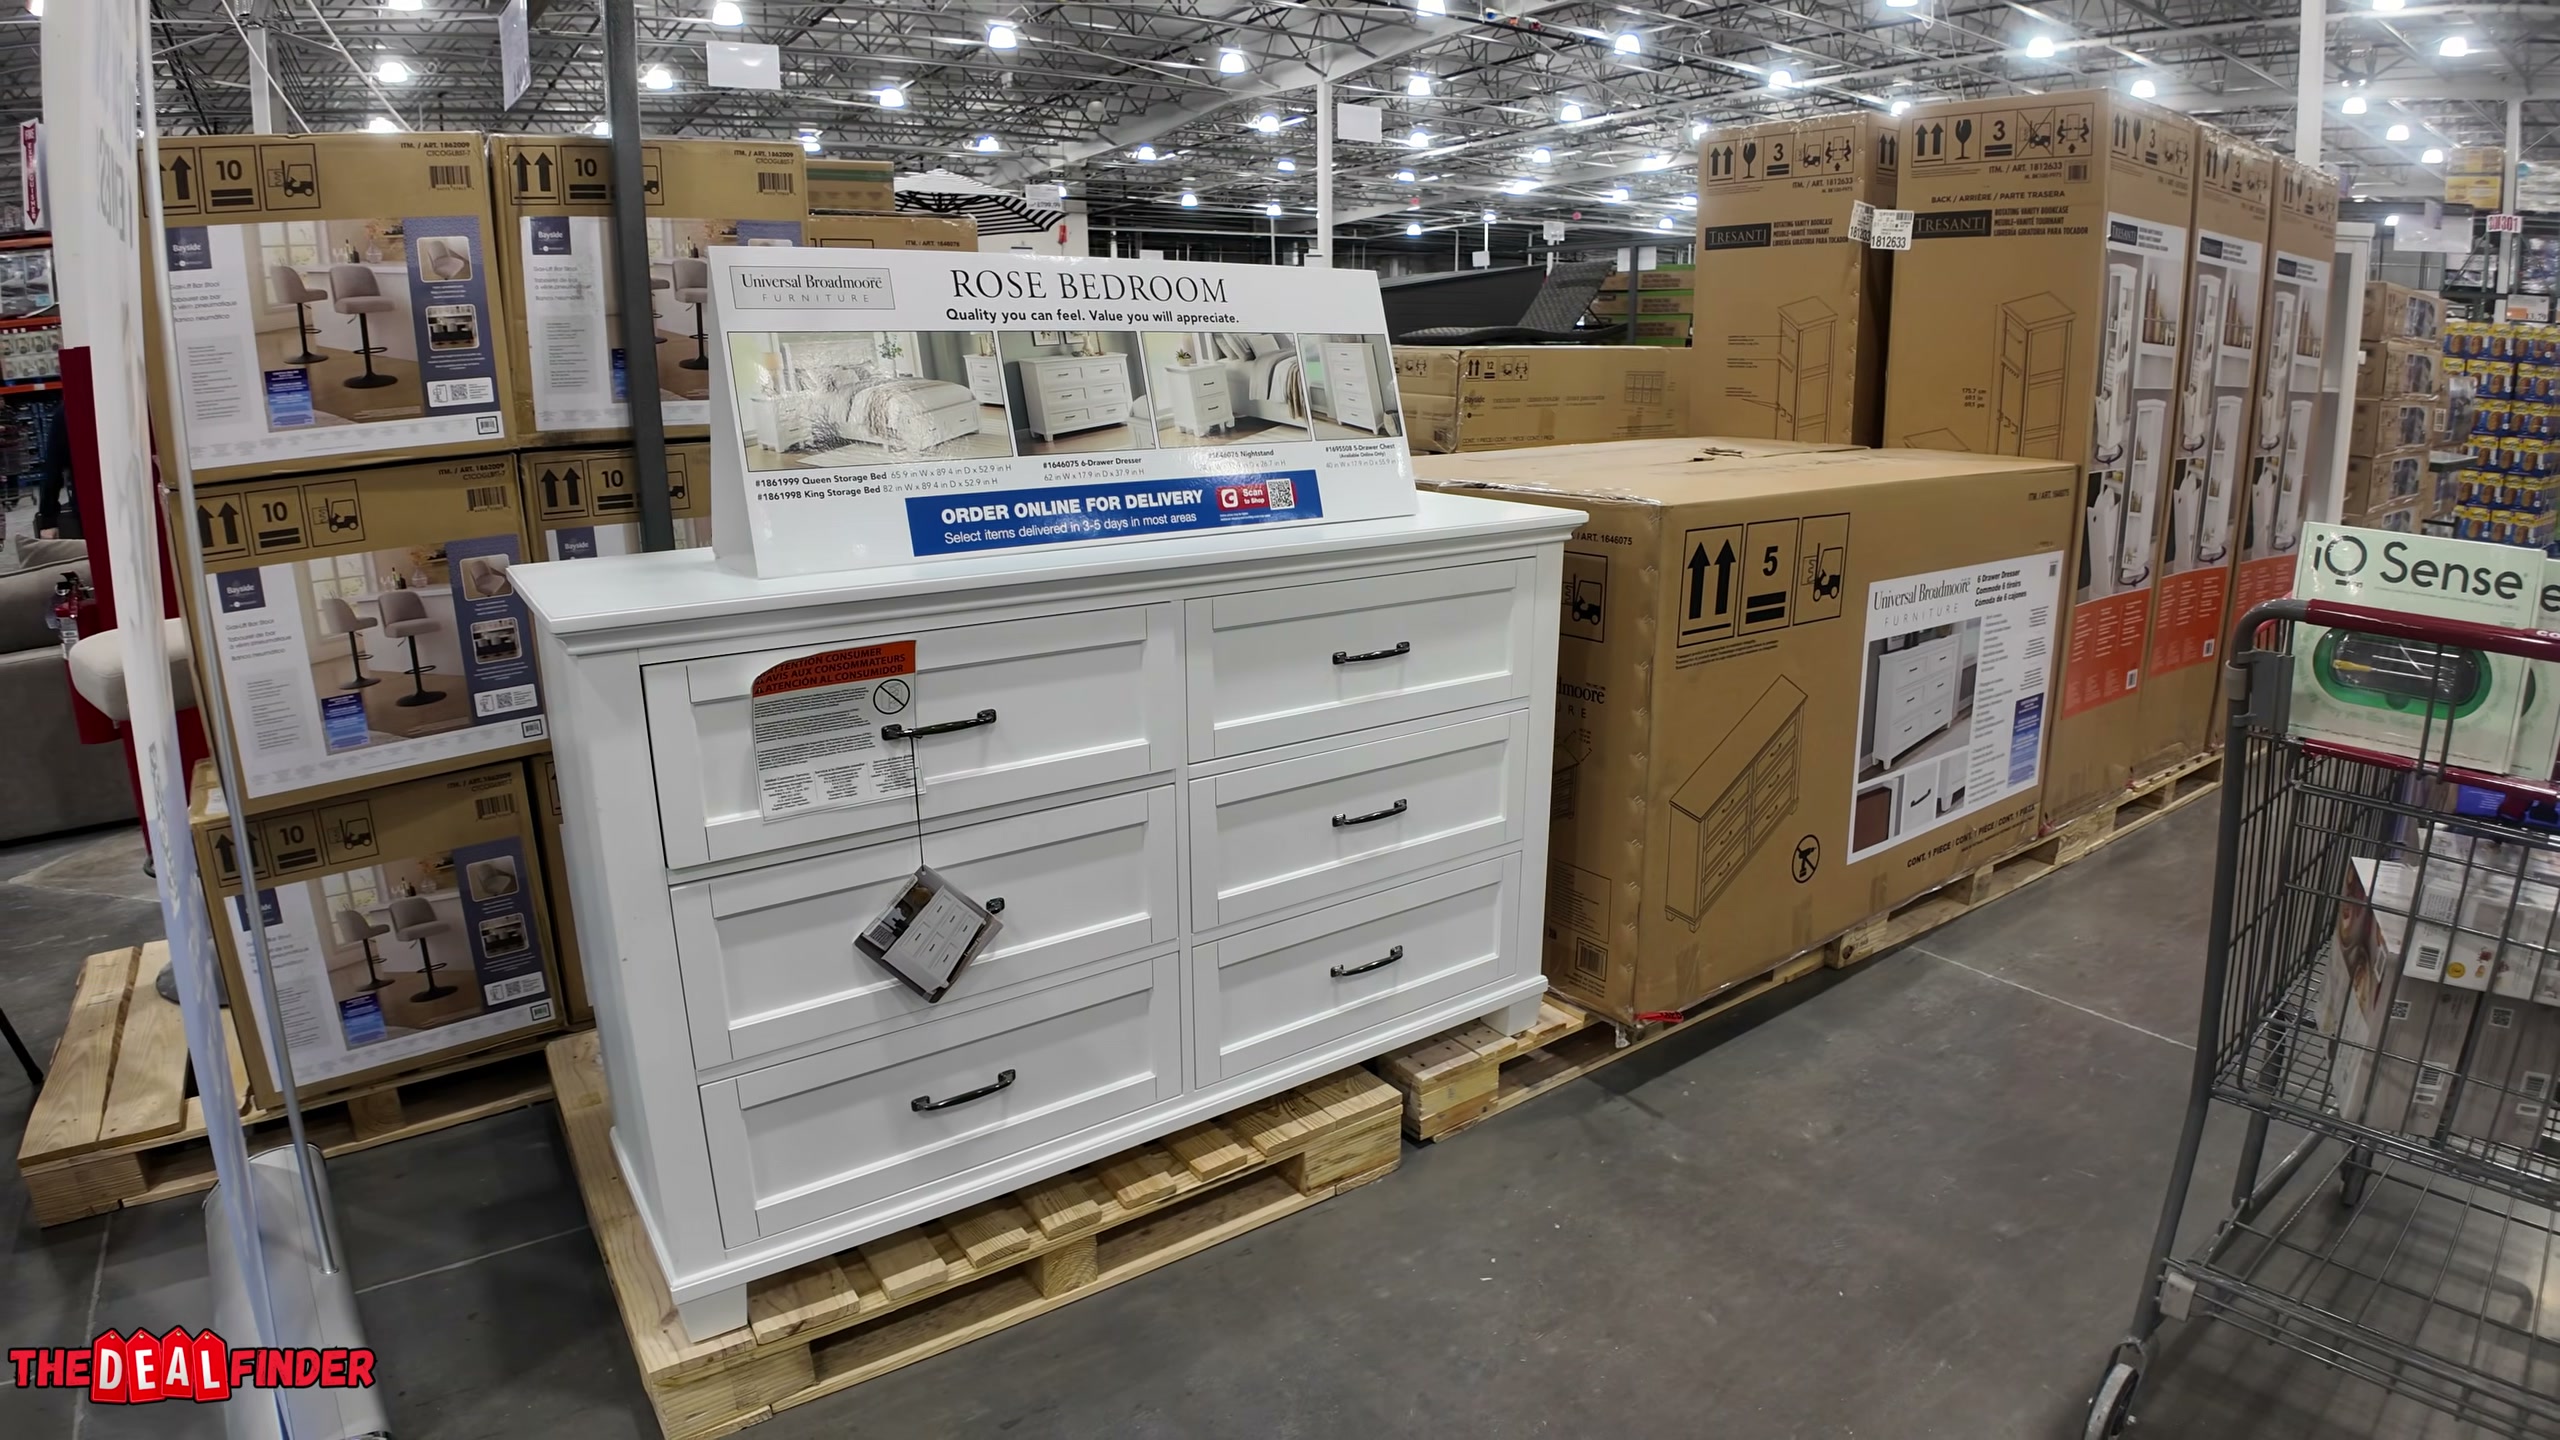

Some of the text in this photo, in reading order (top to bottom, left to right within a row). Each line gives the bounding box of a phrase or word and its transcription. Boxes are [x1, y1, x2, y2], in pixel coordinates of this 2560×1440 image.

[1992, 120, 2006, 141] 3
[2149, 129, 2156, 148] 3
[1772, 142, 1785, 162] 3
[215, 159, 243, 183] 10
[574, 157, 599, 178] 10
[2012, 164, 2027, 172] ART.
[2030, 162, 2062, 171] 1812633
[1812, 179, 1824, 187] ART.
[1827, 177, 1853, 186] 1812633
[2000, 192, 2025, 200] PARTE
[2028, 190, 2065, 199] TRASERA
[1915, 216, 1986, 232] TRESANTI
[538, 231, 563, 240] Bayside
[1872, 236, 1906, 248] 1812633
[173, 243, 201, 253] Bayside
[741, 274, 883, 289] Universal Broadmoore
[950, 270, 1228, 302] ROSE BEDROOM
[762, 293, 869, 303] FURNITURE
[946, 308, 1240, 325] Quality you can feel. Value you will appreciate.
[1240, 450, 1274, 458] Nightstand
[602, 470, 623, 488] 10
[755, 478, 800, 487] #1861999
[802, 476, 832, 485] Queen
[834, 473, 868, 484] Storage
[870, 472, 887, 480] Bed
[919, 469, 928, 477] W
[955, 467, 962, 475] in
[964, 466, 971, 474] D
[804, 489, 825, 501] King
[827, 486, 862, 498] Storage
[864, 485, 881, 494] Bed
[883, 484, 893, 492] 82
[904, 483, 913, 491] W
[941, 481, 948, 489] in
[949, 480, 956, 488] D
[1242, 489, 1263, 497] Scan
[261, 502, 287, 523] 10
[940, 489, 1204, 526] ORDER ONLINE FOR DELIVERY
[944, 511, 1197, 545] Select items delivered in 3-5 days in most areas
[565, 541, 589, 550] Bayside
[1581, 533, 1633, 546] ART. 1646075
[1762, 546, 1779, 576] 5
[1982, 572, 2000, 582] Drawer
[2002, 569, 2020, 579] Dresser
[2379, 541, 2523, 600] Sense
[226, 584, 254, 595] Bayside
[1874, 580, 1971, 610] Universal Broadmoore
[1975, 585, 2001, 595] Commode
[1884, 603, 1958, 627] FURNITURE
[826, 647, 881, 663] CONSUMER
[766, 654, 905, 684] AVIS AUX CONSOMMATEURS
[766, 665, 904, 693] ATENCIÓN AL CONSUMIDOR
[279, 825, 305, 846] 10
[1907, 852, 1926, 868] CONT.
